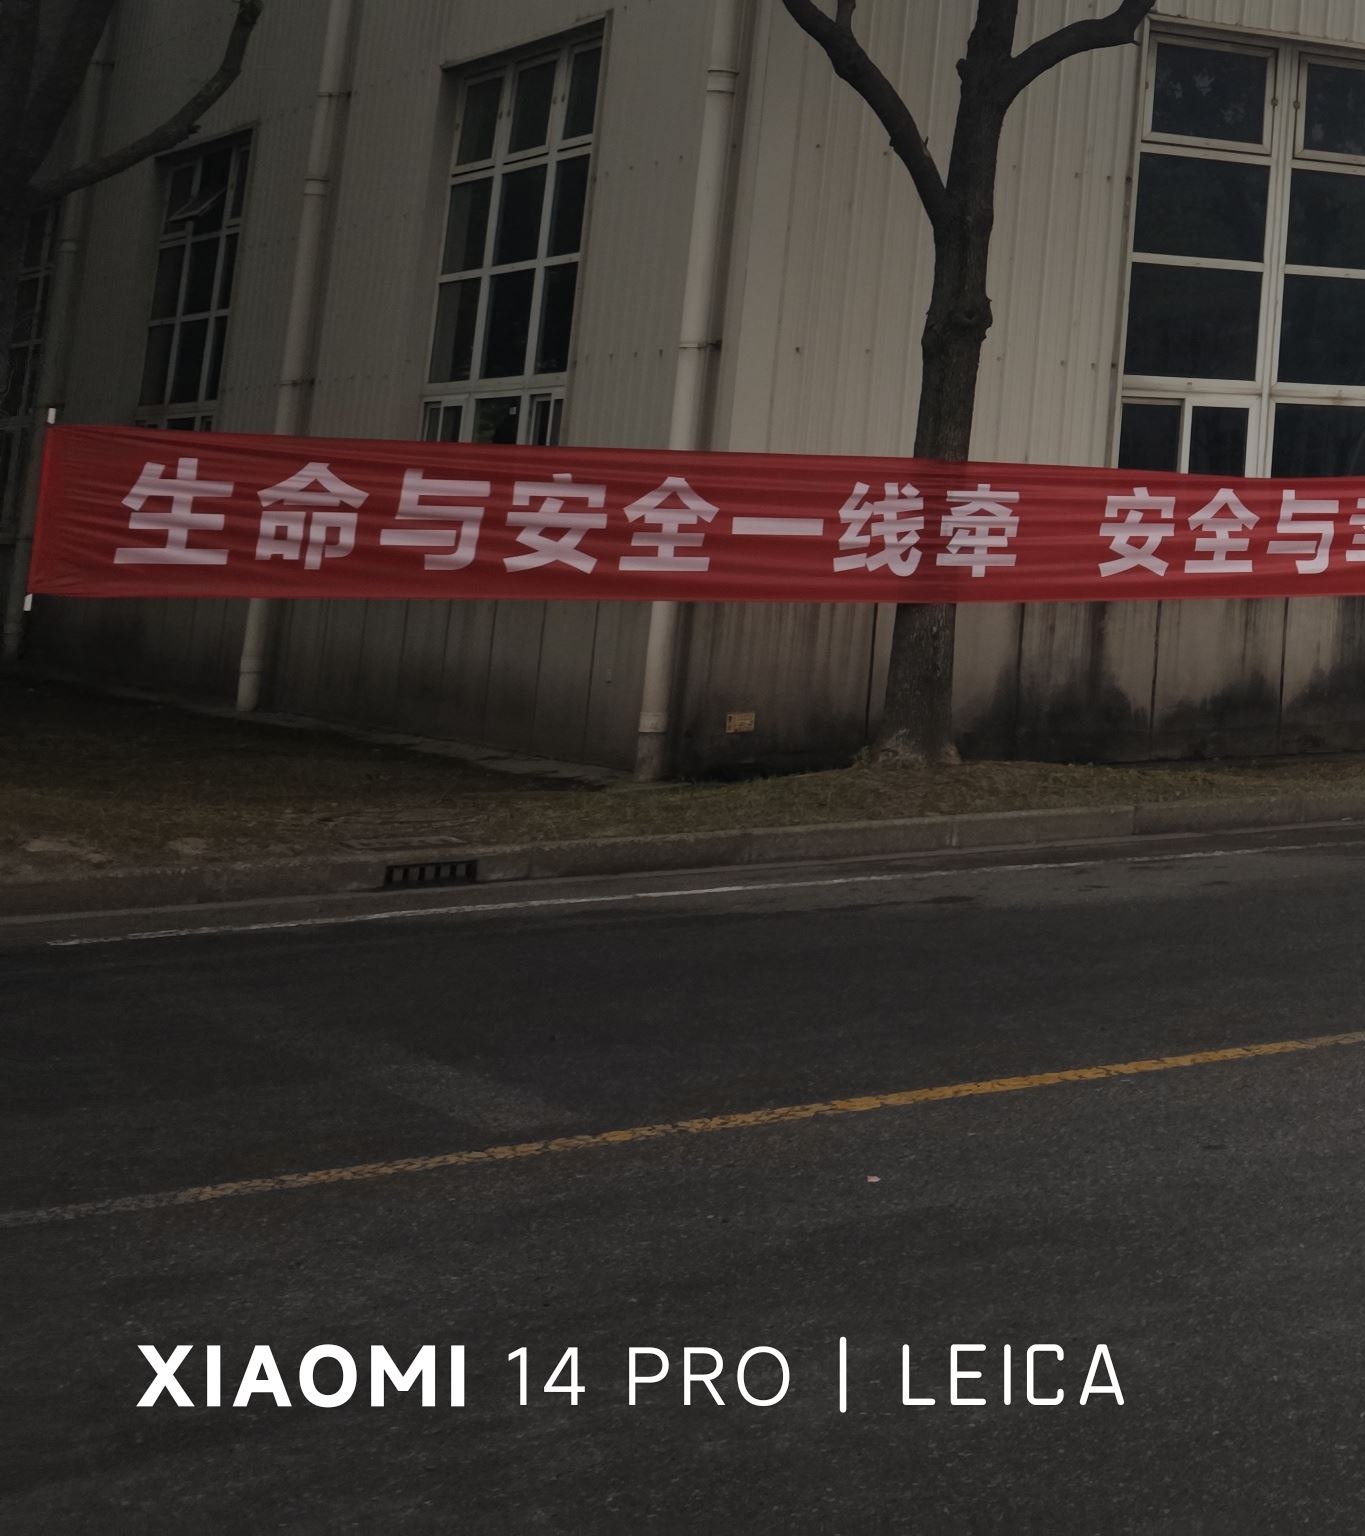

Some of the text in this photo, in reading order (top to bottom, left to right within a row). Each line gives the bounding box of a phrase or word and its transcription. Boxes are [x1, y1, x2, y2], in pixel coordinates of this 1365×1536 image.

[113, 457, 1020, 578] 生命与安全一线牵
